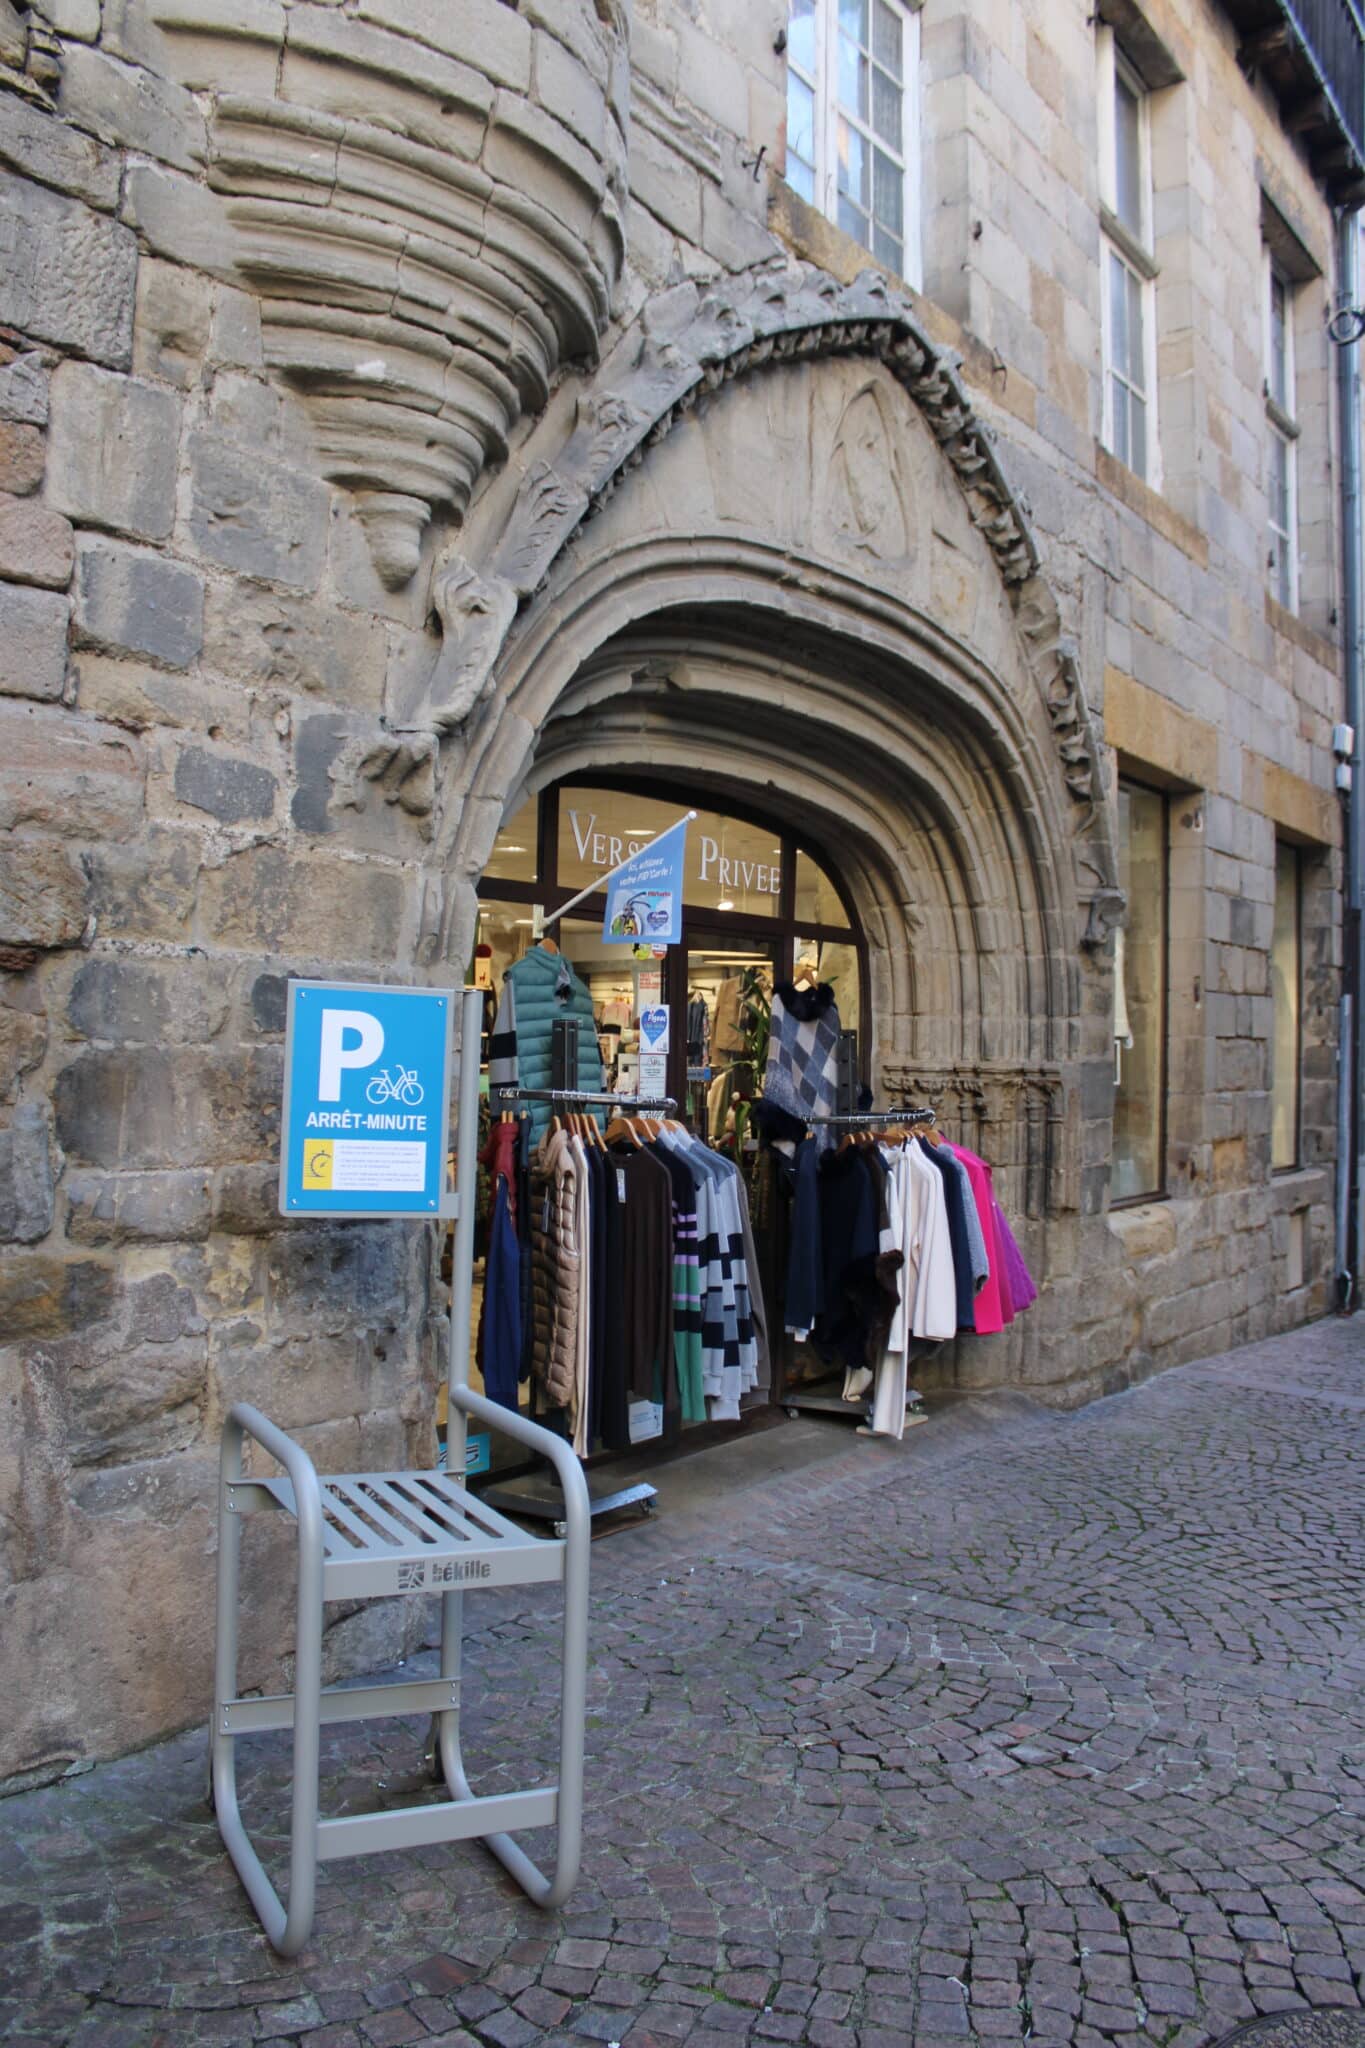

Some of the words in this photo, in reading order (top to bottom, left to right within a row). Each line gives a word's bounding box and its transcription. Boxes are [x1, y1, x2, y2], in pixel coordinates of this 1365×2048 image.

[568, 810, 649, 866] VERS
[697, 836, 781, 894] PRIVEE
[318, 1008, 385, 1102] P
[305, 1109, 427, 1131] ARRÊT-MINUTE
[432, 1559, 491, 1582] békille
